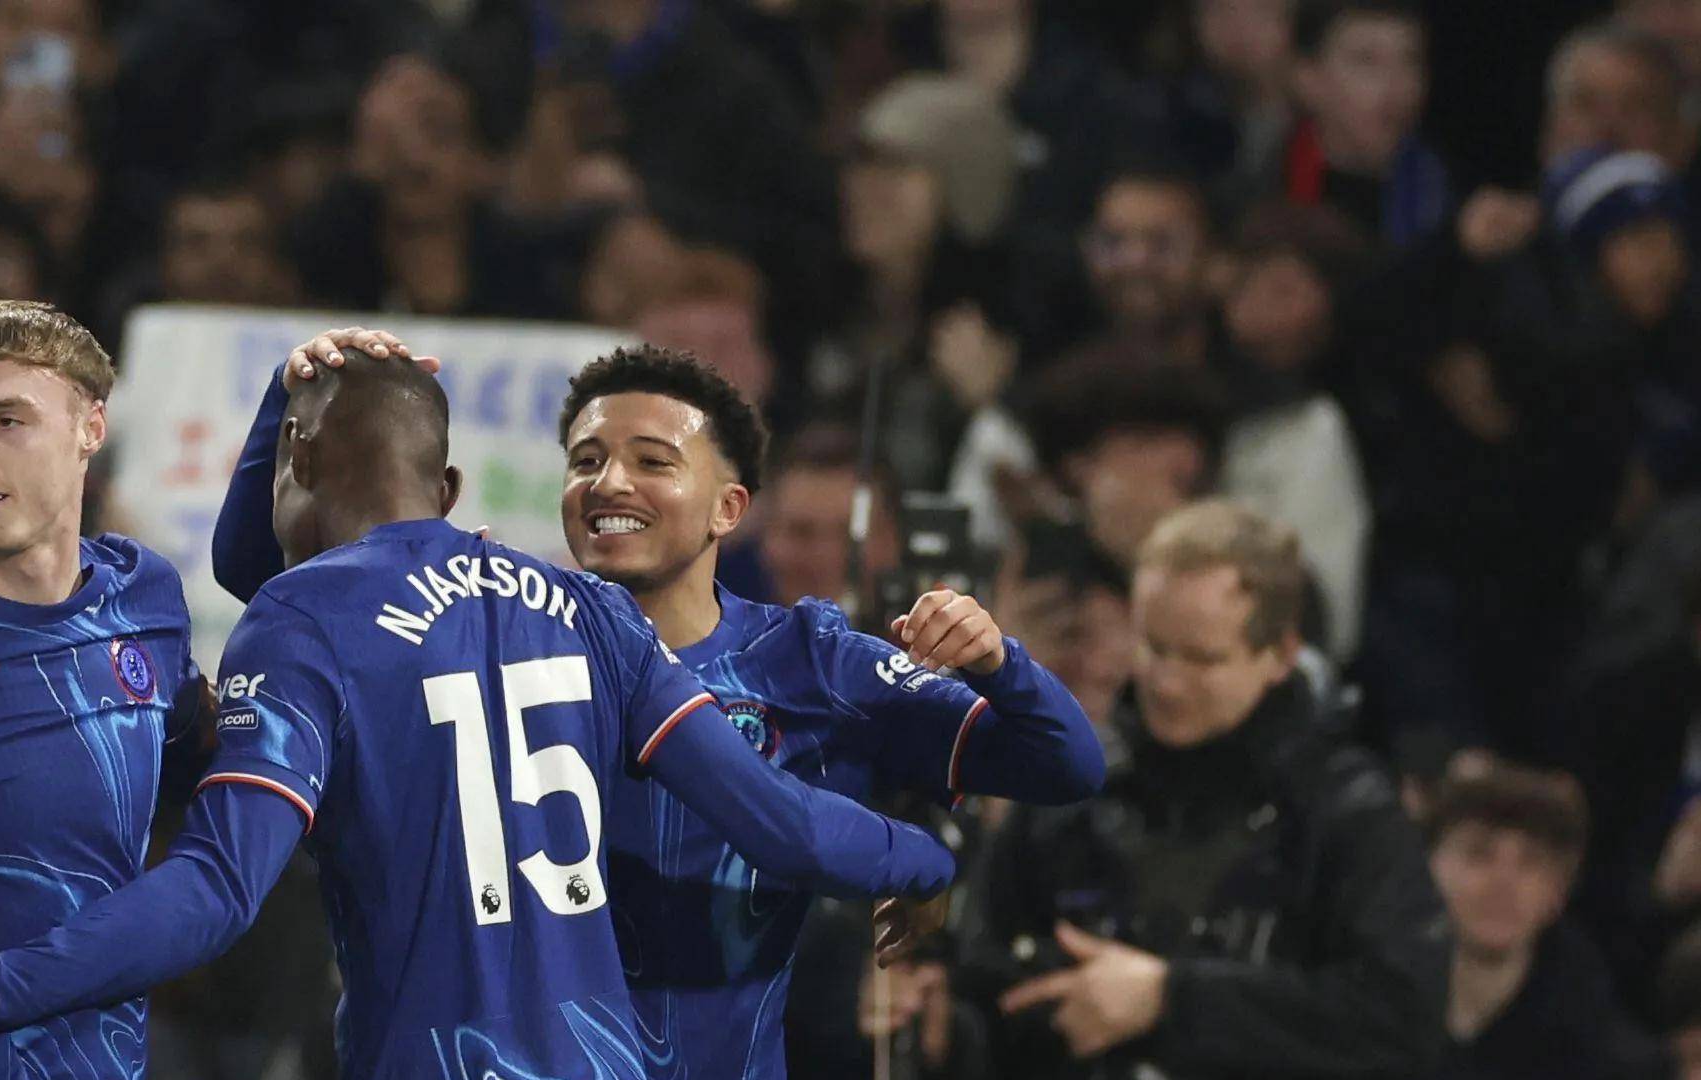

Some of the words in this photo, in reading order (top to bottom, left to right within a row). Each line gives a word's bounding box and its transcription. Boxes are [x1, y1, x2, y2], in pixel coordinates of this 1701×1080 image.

[375, 554, 578, 646] N.JACKSON
[218, 673, 266, 704] ver
[421, 655, 607, 926] 15
